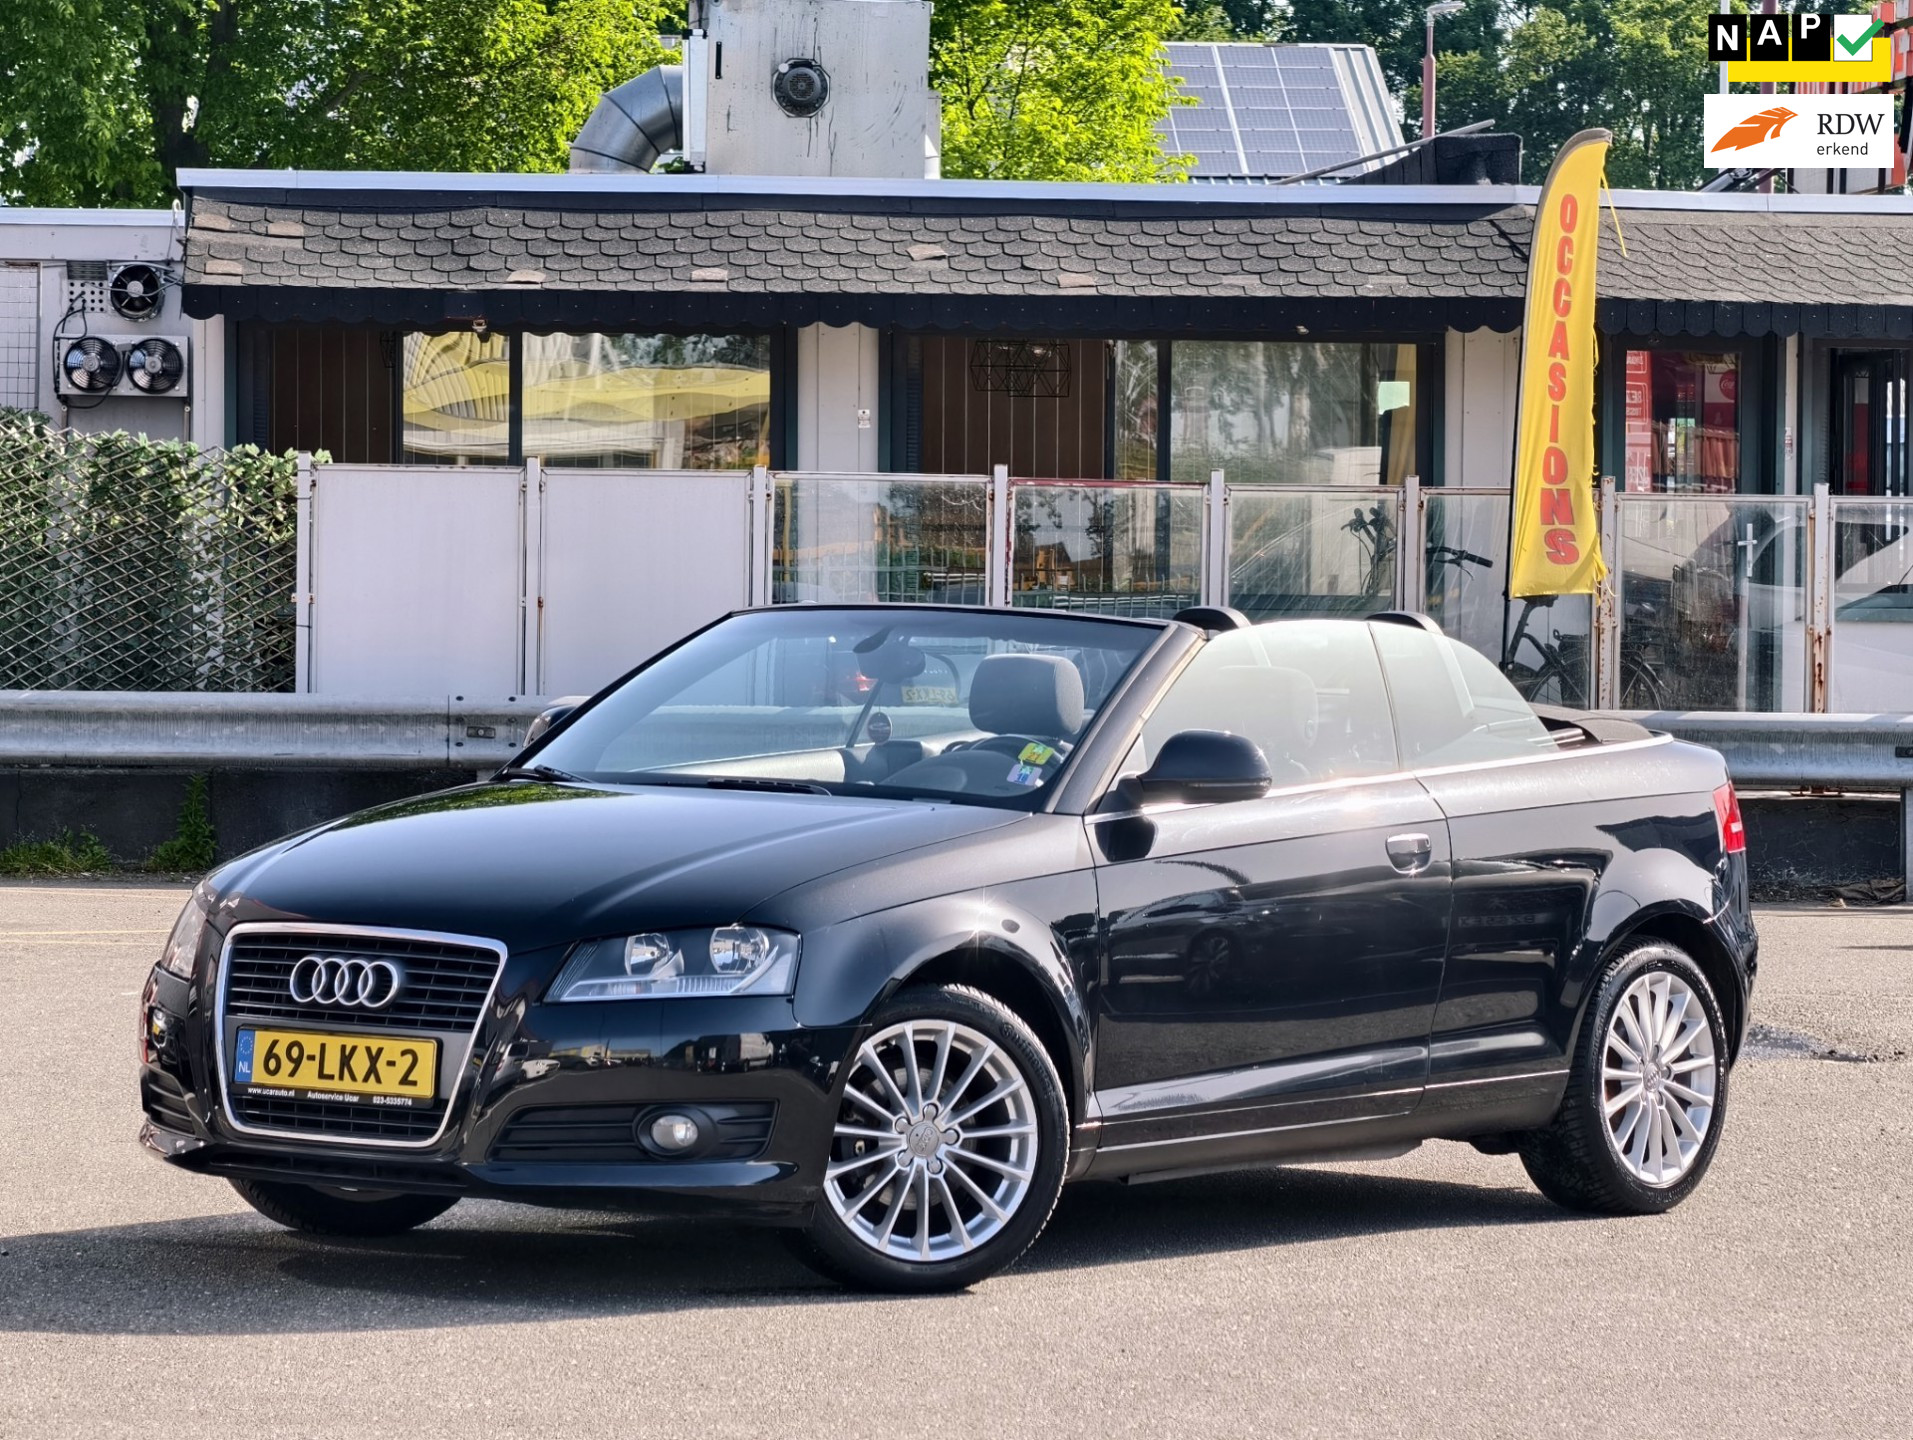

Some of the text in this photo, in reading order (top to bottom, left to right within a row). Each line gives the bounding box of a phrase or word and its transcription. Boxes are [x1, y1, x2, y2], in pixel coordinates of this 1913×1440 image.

[1540, 193, 1580, 565] OCCASIONS
[239, 1061, 250, 1073] NL
[263, 1039, 418, 1087] 69-LKX-2
[248, 1087, 295, 1097] www.ucarauto.nl
[307, 1091, 344, 1101] Autoservice
